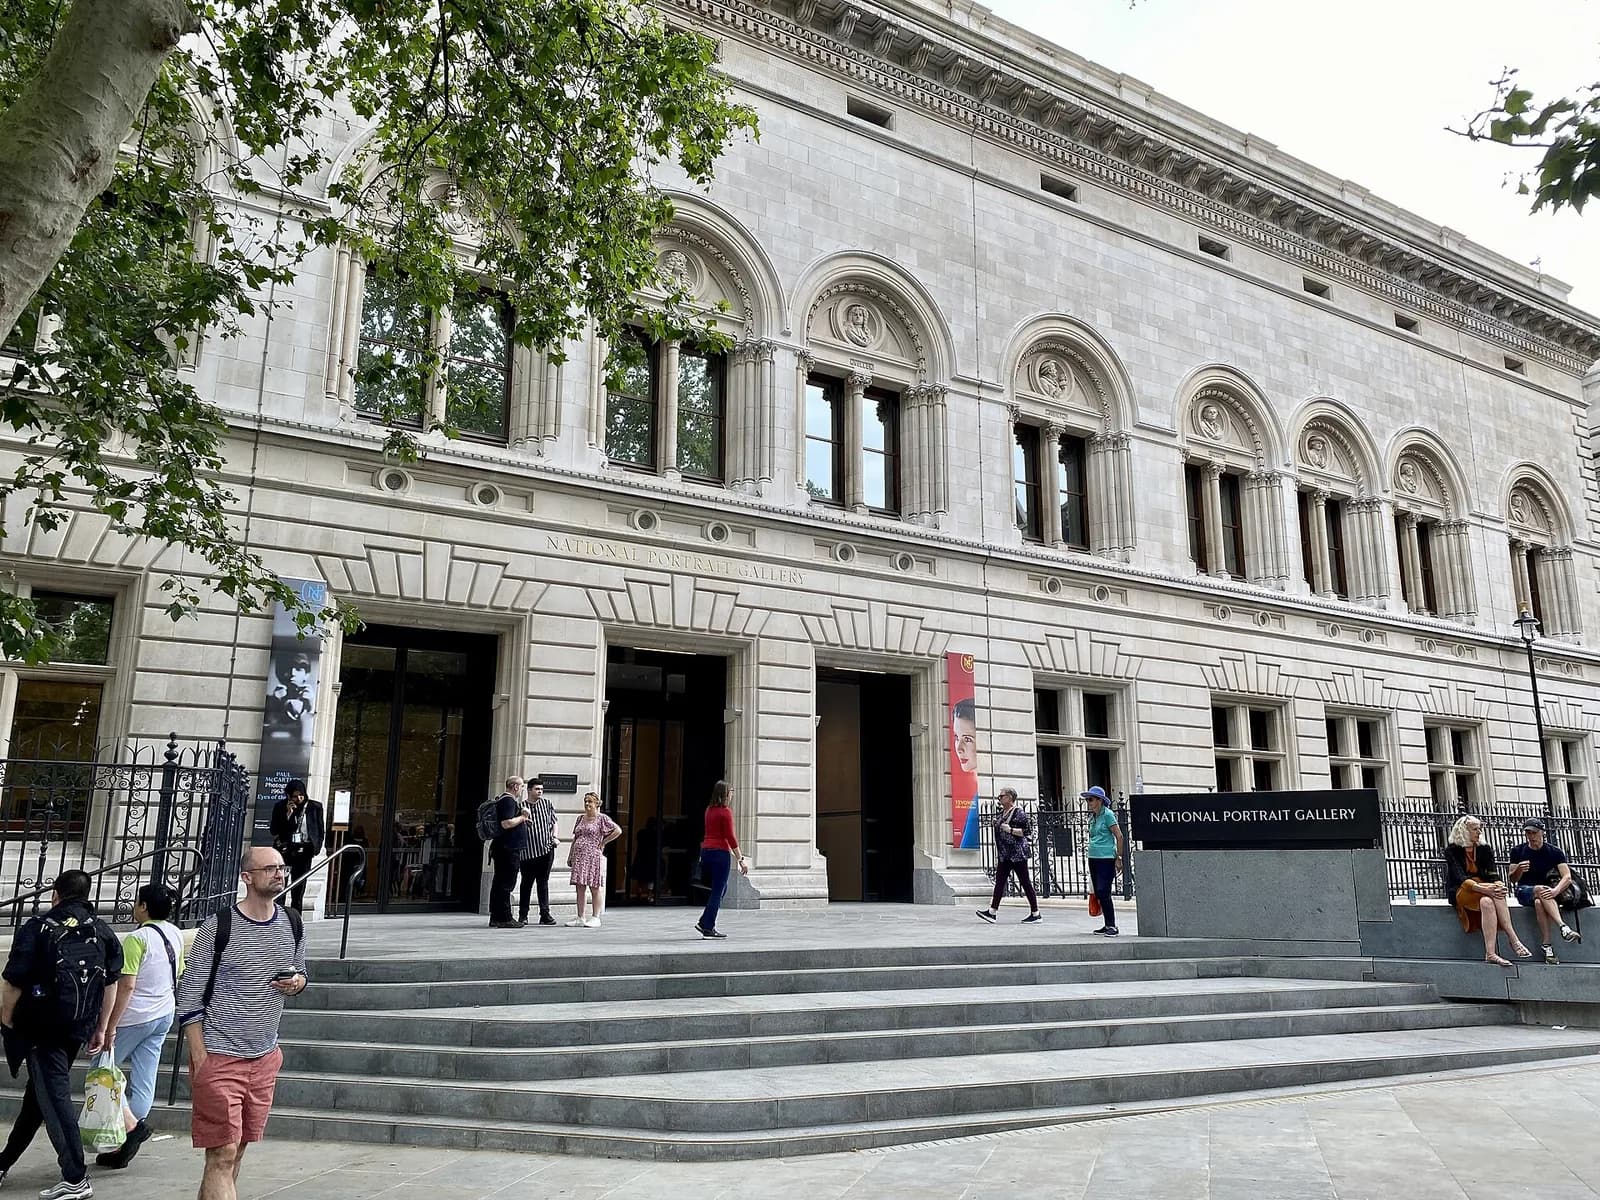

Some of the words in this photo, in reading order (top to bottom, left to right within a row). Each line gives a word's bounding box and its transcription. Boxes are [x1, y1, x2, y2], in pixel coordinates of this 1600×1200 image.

[546, 535, 640, 562] NATIONAL
[648, 551, 733, 575] PORTRAIT
[738, 564, 808, 585] GALLERY
[1150, 811, 1220, 823] NATIONAL
[1223, 809, 1290, 822] PORTRAIT
[1295, 808, 1356, 821] GALLERY
